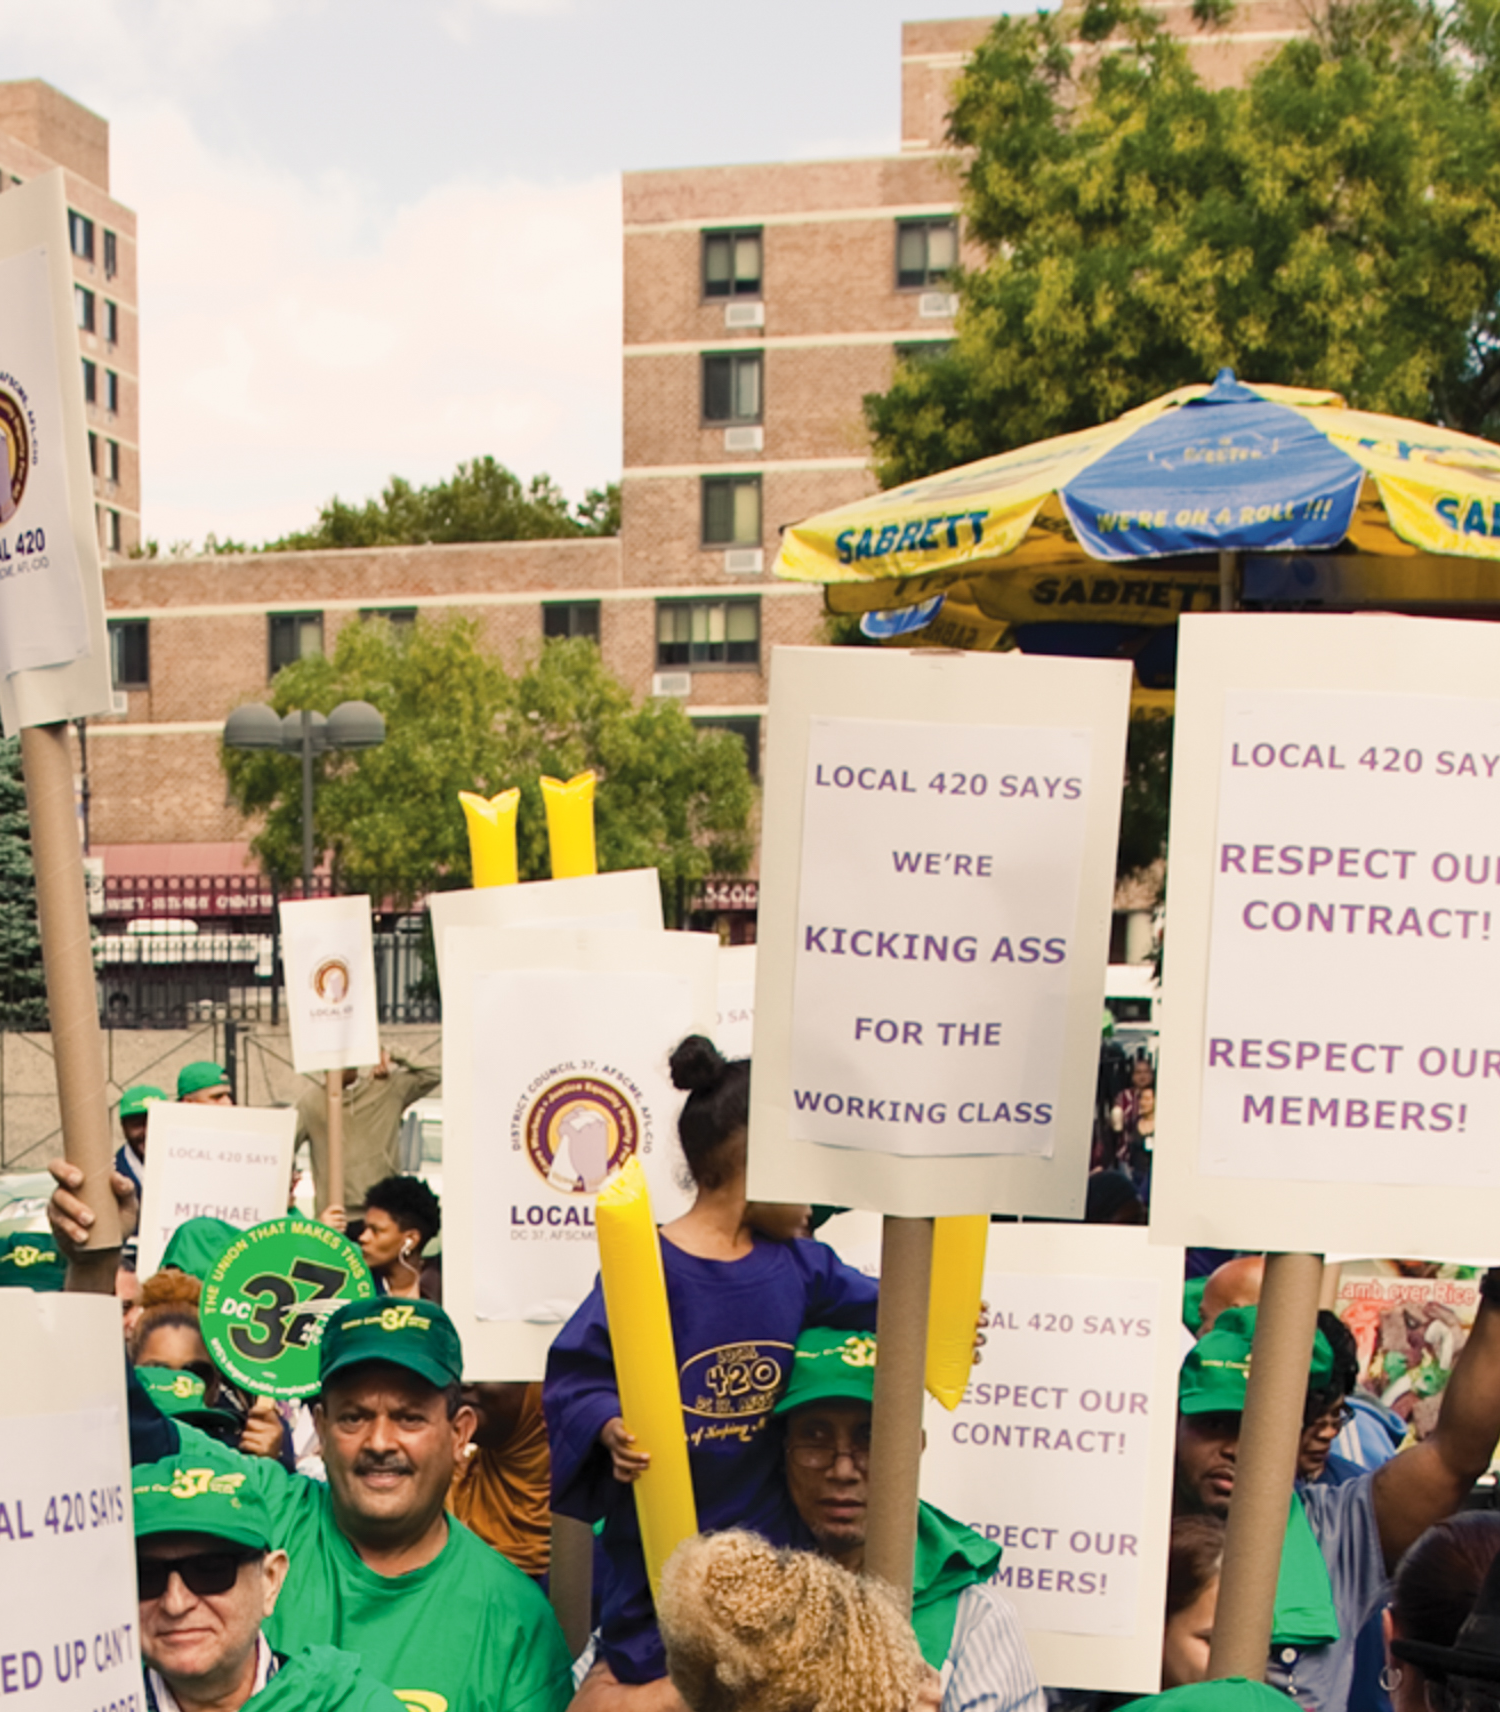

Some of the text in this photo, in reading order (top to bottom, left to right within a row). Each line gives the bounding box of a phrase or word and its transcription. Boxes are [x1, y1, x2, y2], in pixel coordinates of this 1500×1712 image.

[1098, 510, 1167, 533] WE'RE
[1176, 508, 1210, 528] ON
[1216, 507, 1230, 525] A
[1240, 501, 1294, 526] ROLL
[15, 527, 45, 556] 420
[836, 508, 988, 565] SABRETT
[1231, 742, 1346, 770] LOCAL
[1358, 746, 1423, 773] 420
[814, 763, 1083, 800] LOCAL 420 SAYS
[892, 850, 994, 878] WE'RE
[1219, 843, 1417, 880] RESPECT
[1242, 900, 1492, 941] CONTRACT!
[804, 925, 1067, 965] KICKING ASS
[854, 1017, 1002, 1047] FOR THE
[1208, 1038, 1403, 1074] RESPECT
[510, 1094, 530, 1152] DISTRICT
[528, 1061, 576, 1093] COUNCIL
[794, 1089, 1053, 1125] WORKING CLASS
[1242, 1094, 1468, 1133] MEMBERS!
[168, 1146, 278, 1166] LOCAL 420 SAYS
[174, 1202, 263, 1222] MICHAEL
[511, 1205, 595, 1226] LOCAL
[511, 1229, 528, 1241] DC
[204, 1221, 366, 1315] THE UNION THAT MAKES THIS
[1389, 1281, 1476, 1304] over Rice
[221, 1256, 350, 1363] DC 37
[381, 1305, 416, 1331] 37
[1027, 1312, 1152, 1337] 420 SAYS
[706, 1356, 781, 1397] 420
[1078, 1390, 1149, 1415] OUR
[951, 1422, 1127, 1456] CONTRACT!
[170, 1467, 216, 1499] 37
[43, 1491, 88, 1536] 420
[90, 1484, 125, 1531] SAYS
[1069, 1531, 1139, 1557] OUR
[53, 1638, 89, 1684] UP
[92, 1622, 134, 1674] CAN'T
